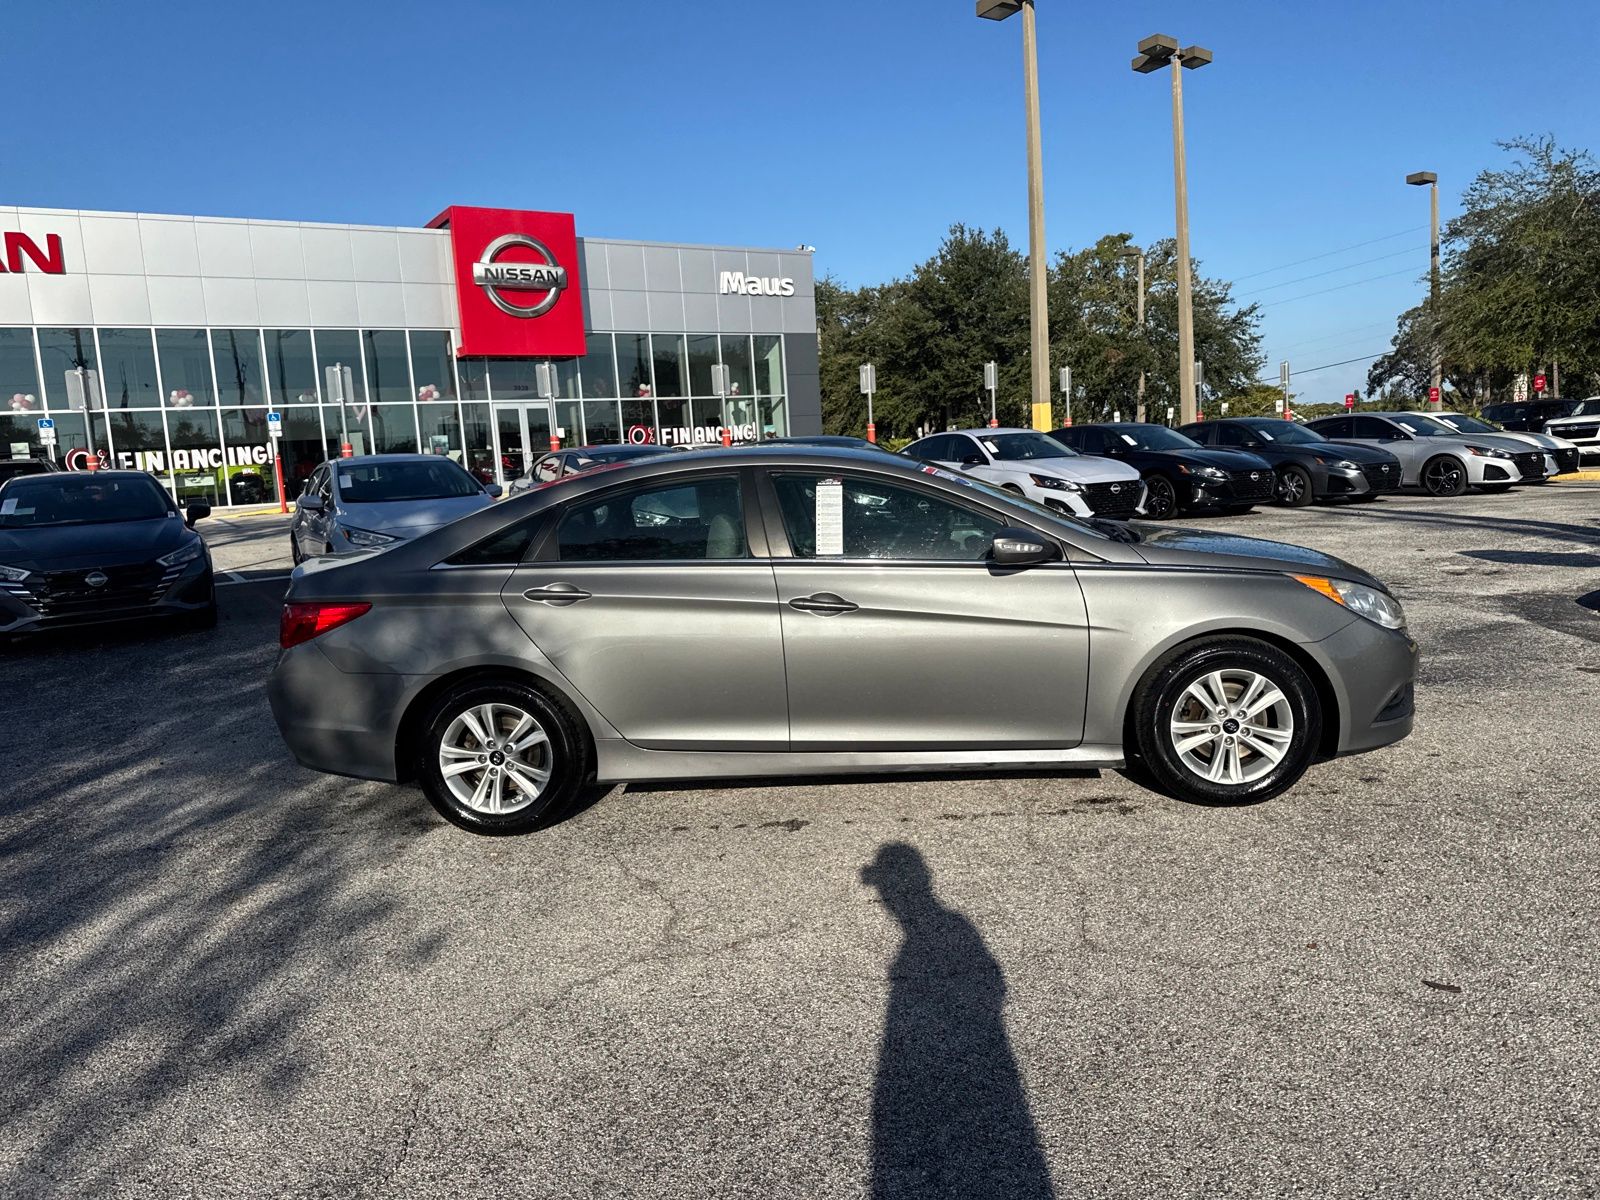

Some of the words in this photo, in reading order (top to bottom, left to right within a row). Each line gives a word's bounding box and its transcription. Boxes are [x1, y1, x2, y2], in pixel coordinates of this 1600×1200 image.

[484, 268, 559, 282] NISSAN
[720, 271, 795, 296] Maus
[628, 424, 656, 444] 0%
[661, 421, 757, 444] FINANCING!
[117, 441, 273, 471] FINANCING!
